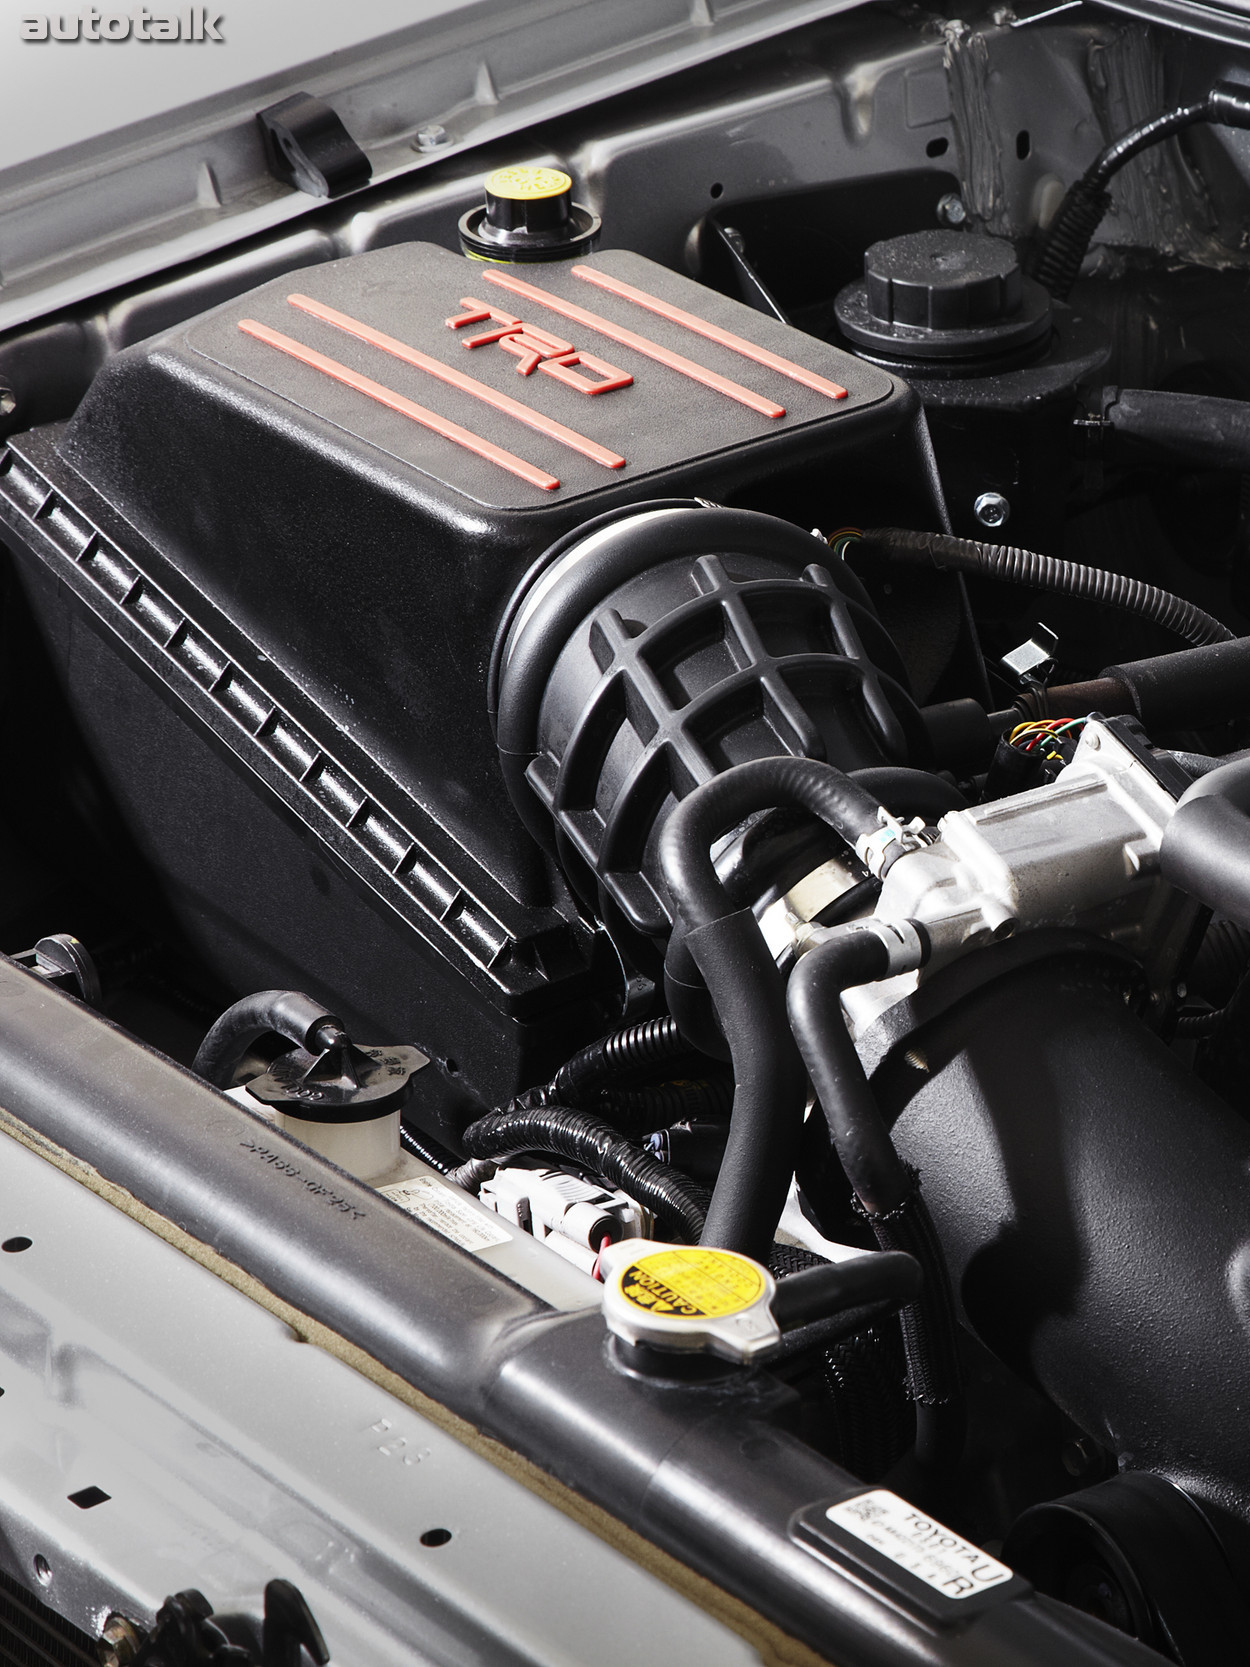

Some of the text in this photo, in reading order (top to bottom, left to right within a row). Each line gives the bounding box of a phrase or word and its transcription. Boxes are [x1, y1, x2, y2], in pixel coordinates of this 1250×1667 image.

[445, 296, 634, 395] TRD
[628, 1269, 698, 1314] CAUTION
[905, 1513, 979, 1563] TOYOTA
